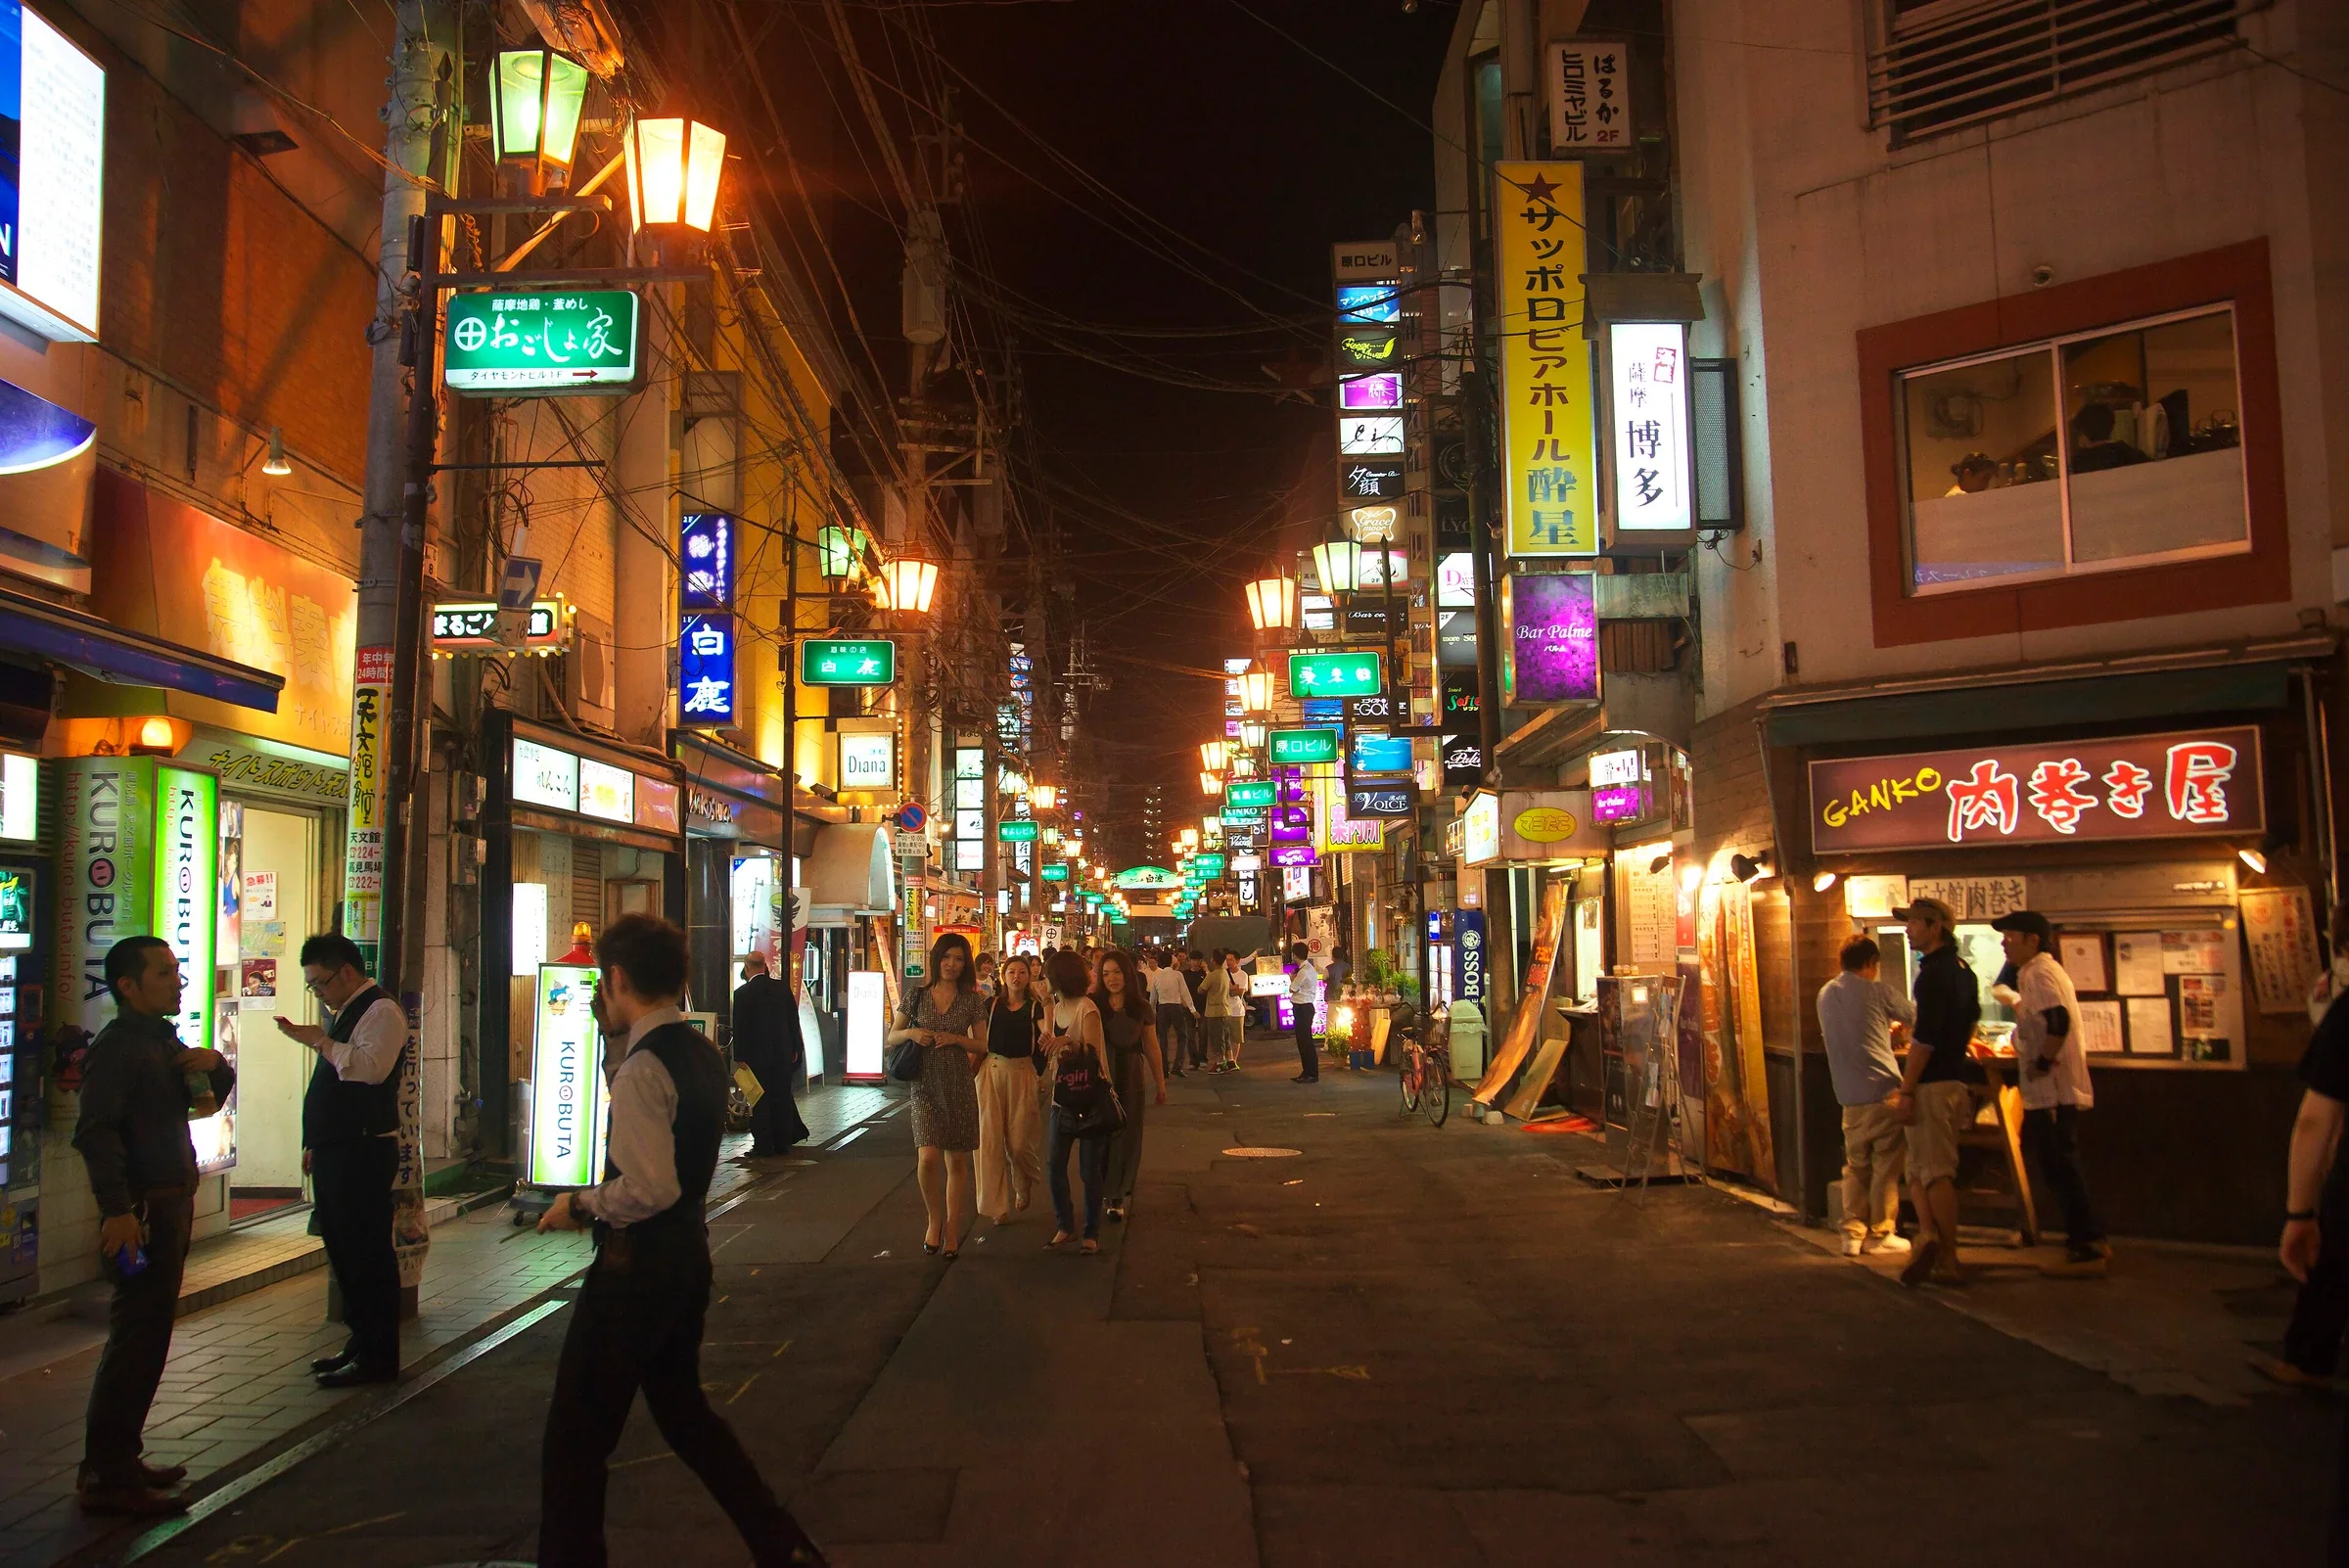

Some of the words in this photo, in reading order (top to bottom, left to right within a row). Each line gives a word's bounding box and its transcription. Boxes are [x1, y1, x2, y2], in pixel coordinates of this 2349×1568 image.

[1561, 49, 1588, 142] ヒロミヤビル
[1593, 53, 1620, 125] はるか
[1596, 129, 1620, 143] 2F
[1342, 254, 1392, 267] 原口ビル
[489, 306, 623, 363] おごじょ家
[1626, 419, 1663, 508] 博多
[1359, 517, 1391, 527] Grace
[1517, 624, 1545, 639] Bar
[1548, 623, 1592, 639] Palme
[684, 623, 731, 714] 白鹿
[1275, 739, 1332, 754] 原口ビル
[849, 755, 886, 773] Diana
[1822, 766, 1942, 829] GANKO
[1945, 741, 2238, 844] 肉巻き屋
[1225, 807, 1258, 816] KINKO
[1520, 814, 1571, 832] マヨたこ
[349, 832, 385, 844] 天文館
[356, 847, 384, 858] 224-
[355, 876, 382, 889] 222-
[1463, 949, 1480, 997] BOSS
[556, 1040, 576, 1159] KUROBUTA
